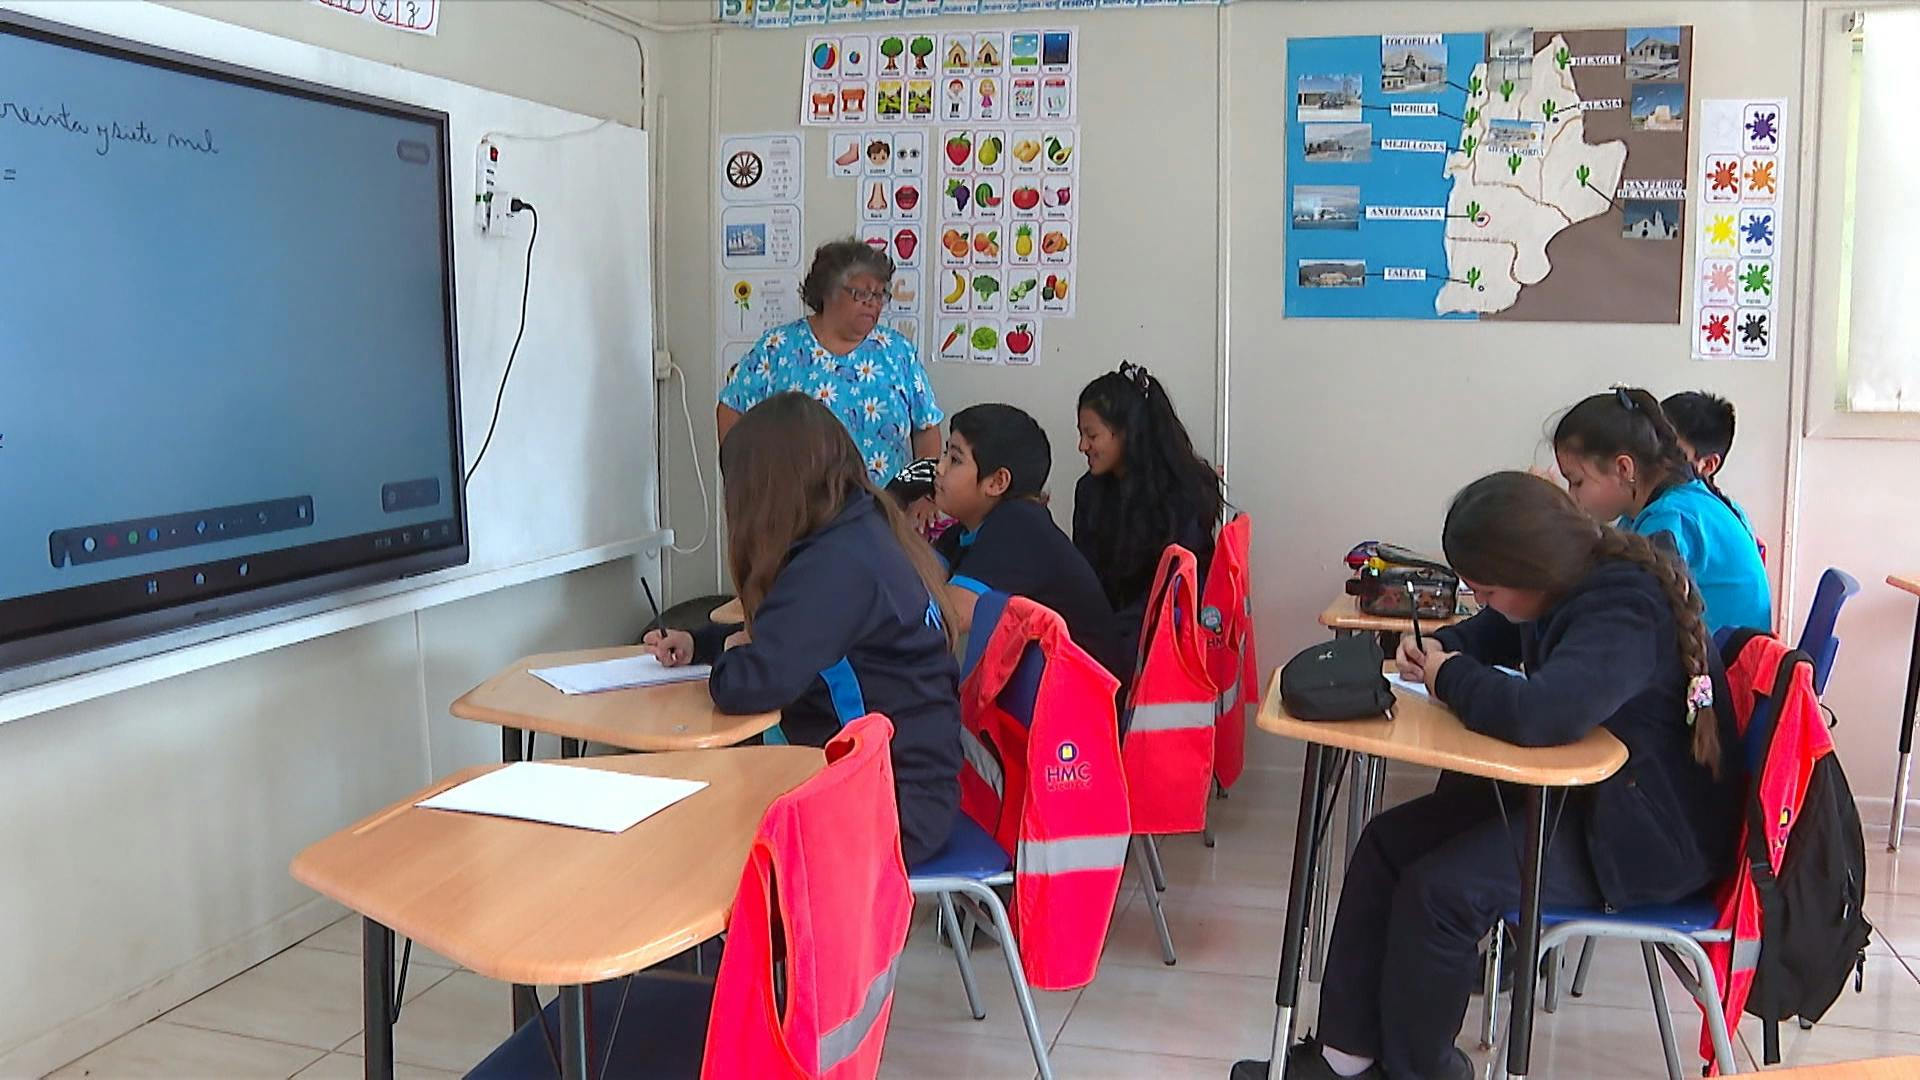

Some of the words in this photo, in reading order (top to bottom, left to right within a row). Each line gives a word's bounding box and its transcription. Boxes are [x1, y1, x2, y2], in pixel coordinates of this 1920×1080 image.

[1393, 104, 1437, 114] MICHILLA
[0, 102, 88, 134] reinta
[1370, 207, 1442, 218] ANTOFAGASTA
[1047, 763, 1091, 782] HMC
